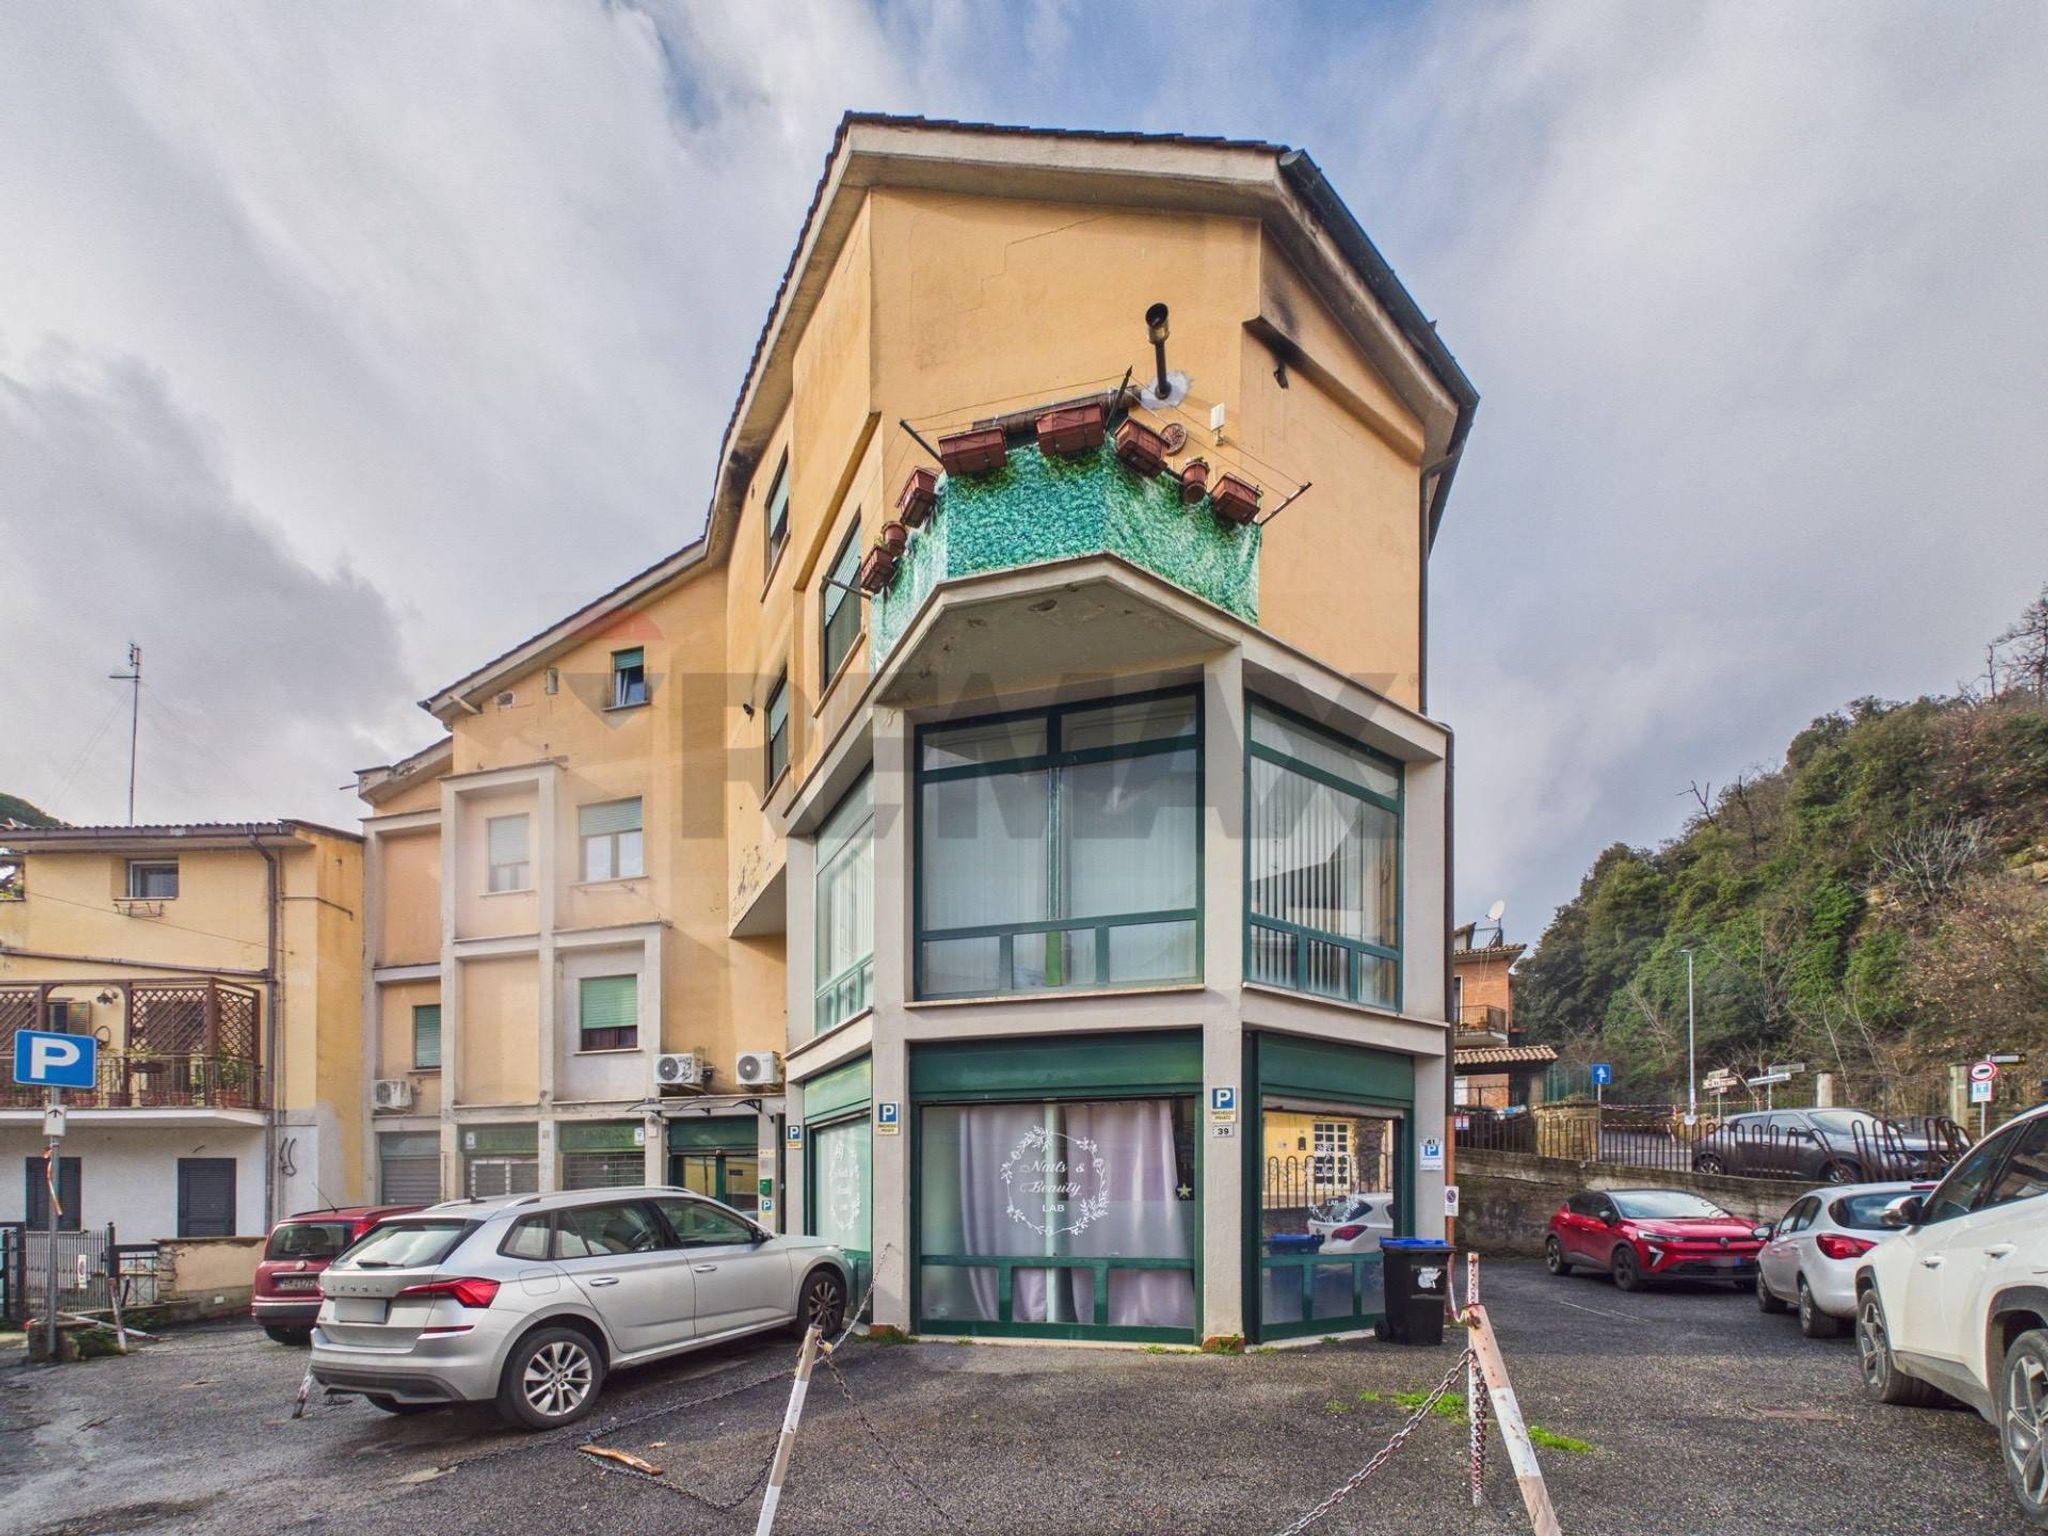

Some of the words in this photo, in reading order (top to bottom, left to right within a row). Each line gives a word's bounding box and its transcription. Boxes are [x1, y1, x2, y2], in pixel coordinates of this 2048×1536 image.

[30, 1037, 81, 1079] P
[1216, 1090, 1231, 1108] P
[882, 1104, 894, 1121] P
[789, 1125, 800, 1140] P
[1217, 1127, 1230, 1136] 39
[1426, 1145, 1437, 1156] P
[1020, 1159, 1068, 1173] Nails
[1019, 1179, 1082, 1198] Beauty
[763, 1200, 772, 1211] P
[1041, 1203, 1065, 1212] LAB
